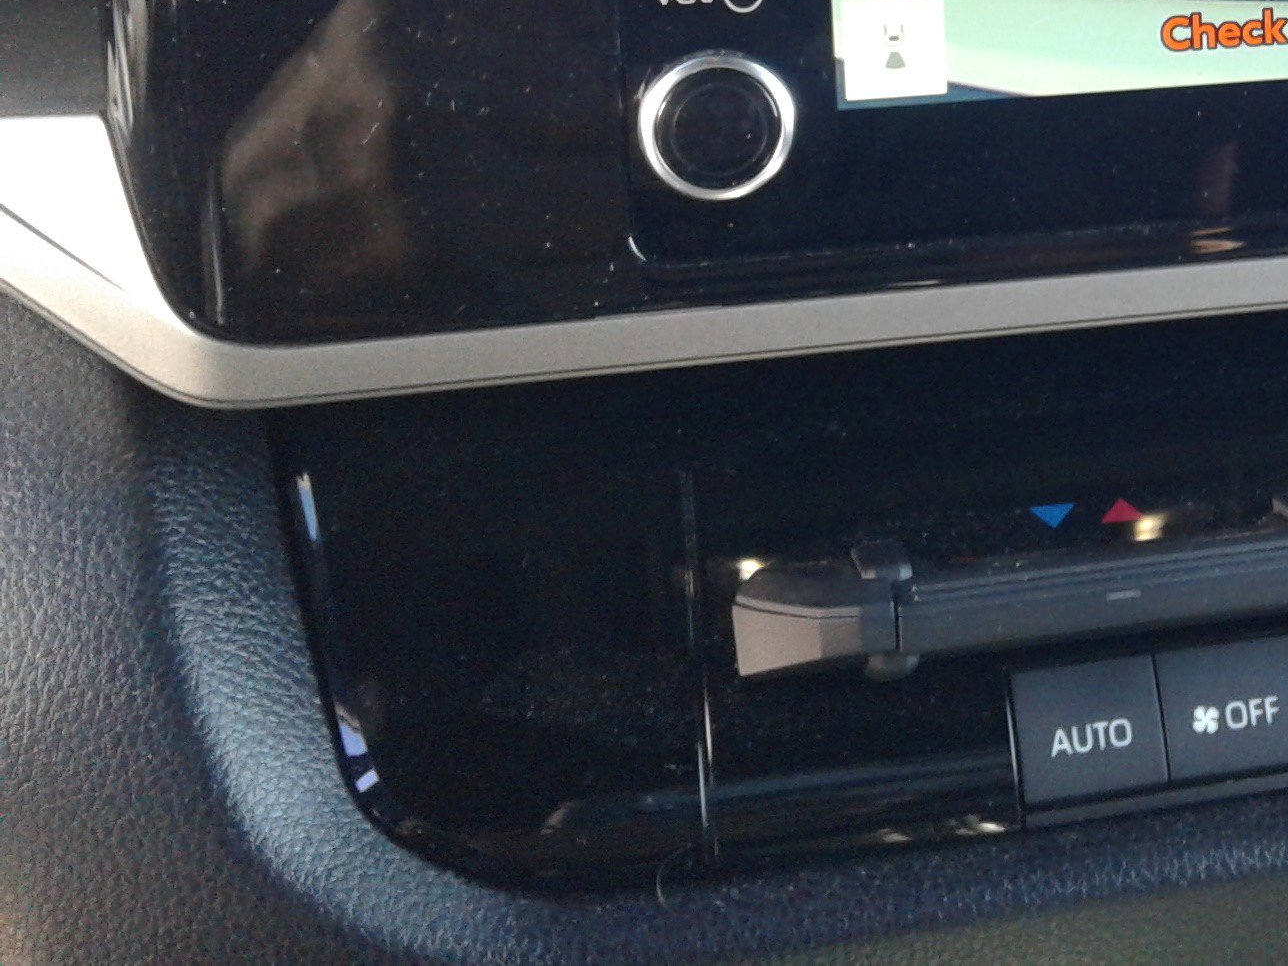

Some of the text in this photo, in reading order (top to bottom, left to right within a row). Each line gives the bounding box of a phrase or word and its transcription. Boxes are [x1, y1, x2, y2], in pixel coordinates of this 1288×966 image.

[1160, 8, 1288, 52] Check
[1225, 695, 1280, 731] OFF
[1051, 717, 1134, 759] AUTO
